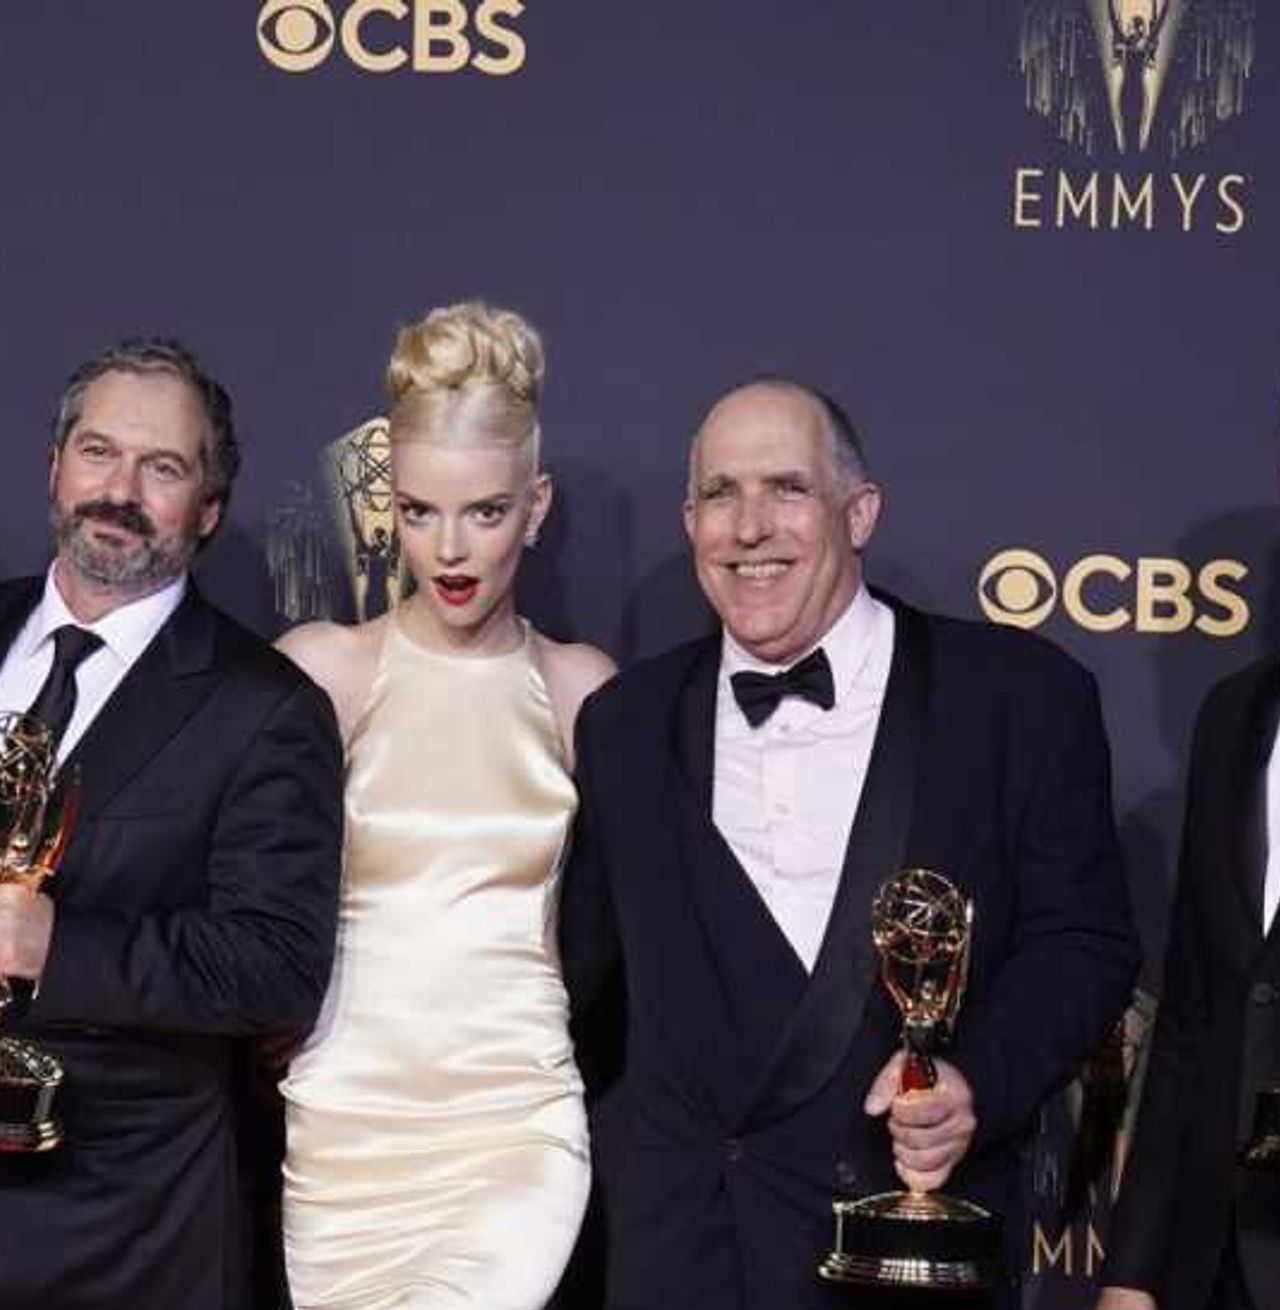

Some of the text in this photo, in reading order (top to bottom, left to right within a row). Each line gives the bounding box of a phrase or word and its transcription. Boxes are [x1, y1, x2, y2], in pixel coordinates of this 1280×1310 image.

[341, 0, 526, 75] CBS
[1014, 168, 1245, 233] EMMYS
[1063, 555, 1250, 636] CBS
